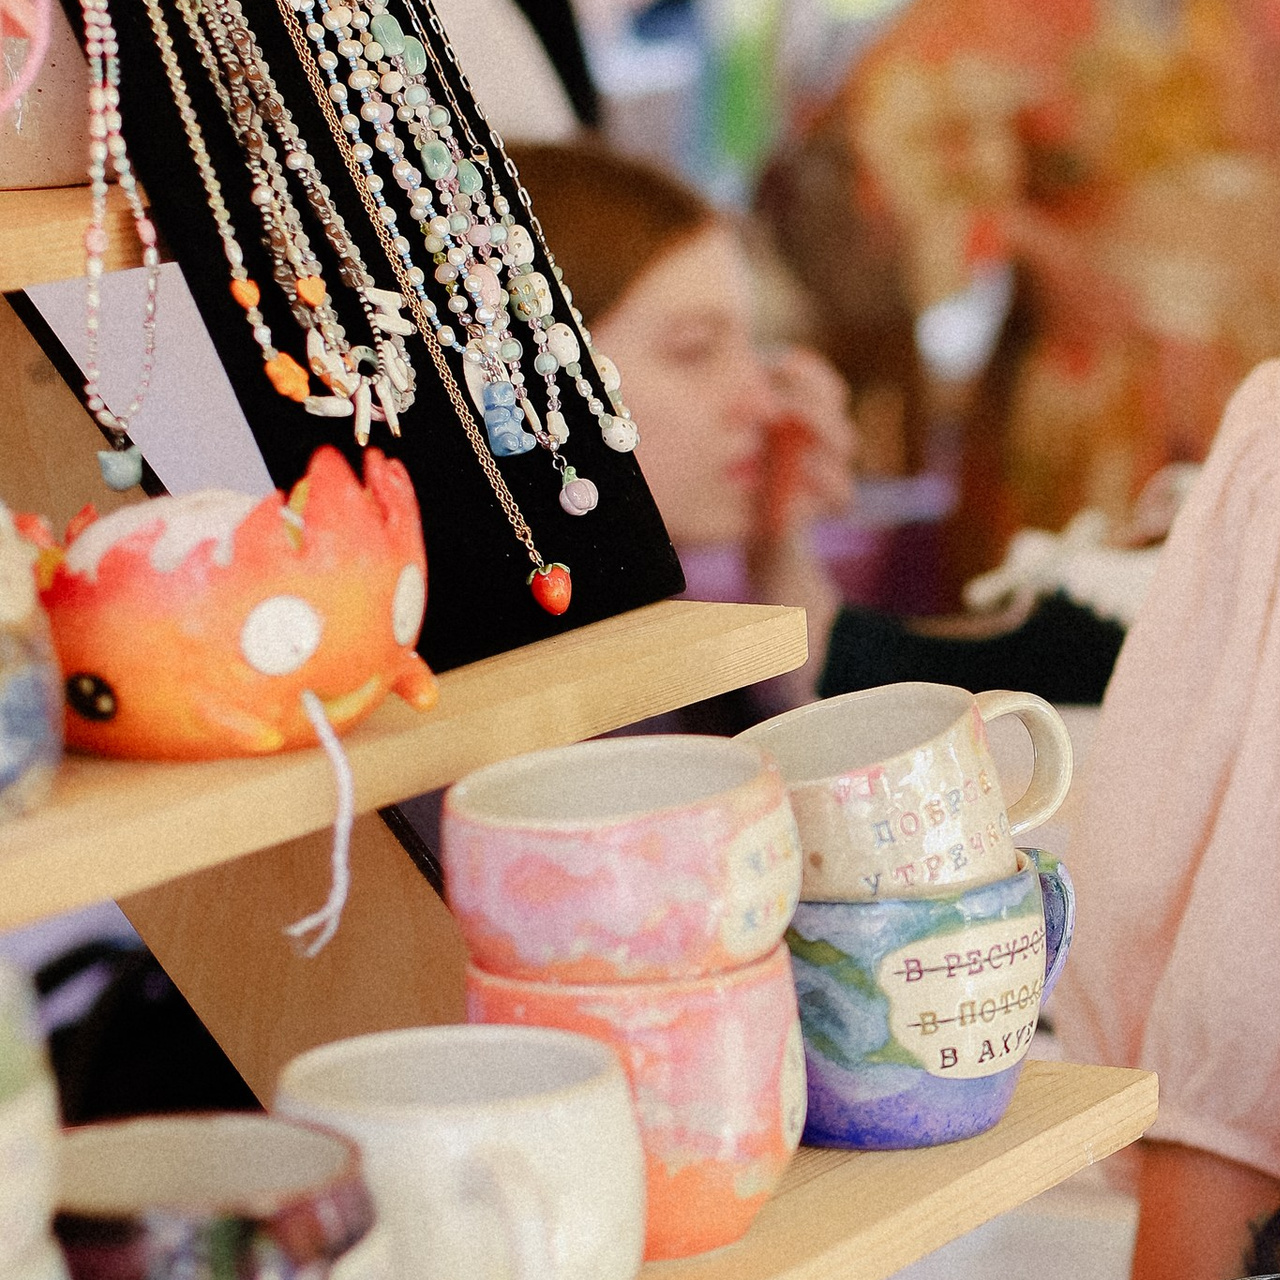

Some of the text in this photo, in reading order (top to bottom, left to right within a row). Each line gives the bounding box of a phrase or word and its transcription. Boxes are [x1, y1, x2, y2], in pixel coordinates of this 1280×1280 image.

[904, 958, 924, 982] В
[919, 1011, 940, 1036] В
[940, 1047, 958, 1069] В
